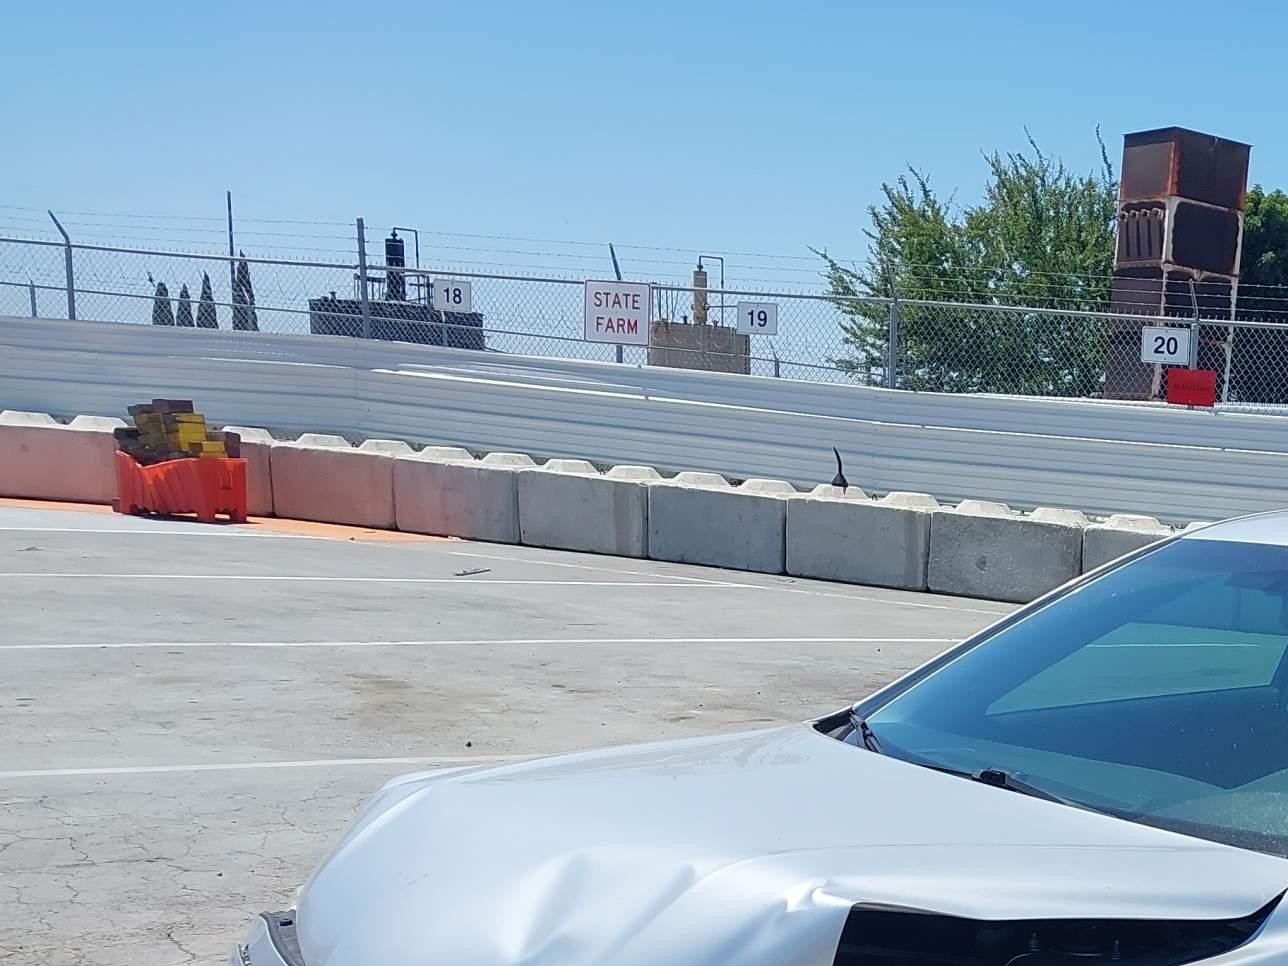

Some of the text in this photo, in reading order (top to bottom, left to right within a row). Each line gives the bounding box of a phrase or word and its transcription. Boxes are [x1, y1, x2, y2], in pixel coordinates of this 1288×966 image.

[443, 287, 463, 305] 18
[593, 292, 642, 311] STATE
[595, 316, 639, 335] FARM
[747, 309, 769, 328] 19
[1153, 335, 1178, 356] 20
